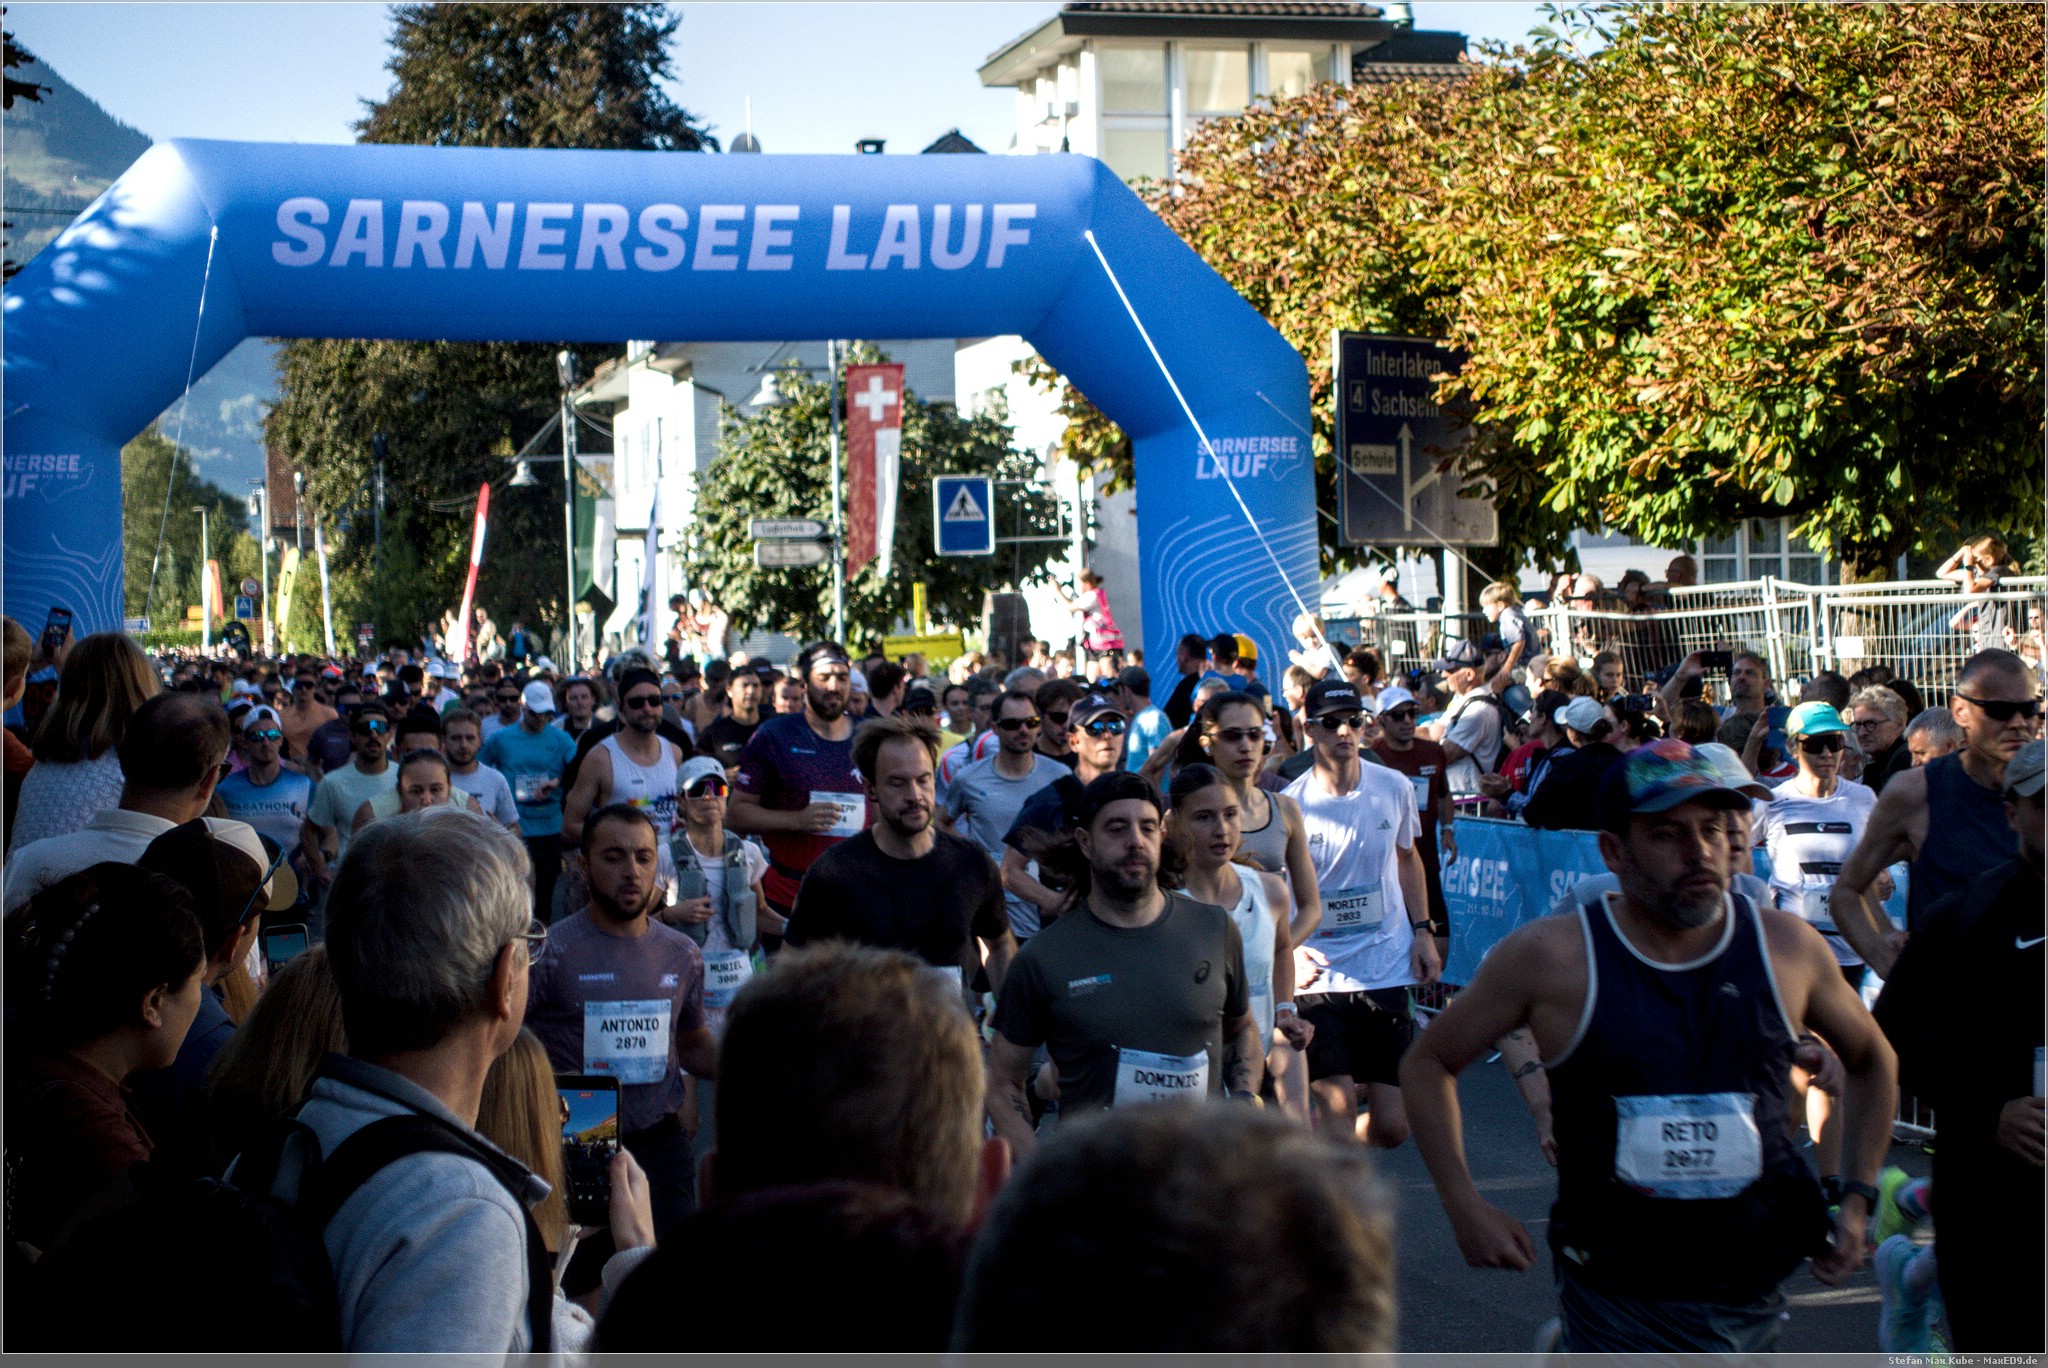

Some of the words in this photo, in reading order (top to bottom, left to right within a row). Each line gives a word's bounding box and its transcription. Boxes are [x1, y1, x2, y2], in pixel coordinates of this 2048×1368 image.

[272, 197, 799, 271] SARNERSEE
[826, 203, 1036, 270] LAUF
[1367, 348, 1441, 379] Interlaken
[1353, 385, 1362, 406] 4
[1197, 436, 1298, 455] SARNERSEE
[1195, 454, 1268, 480] LAUF
[1354, 450, 1394, 468] Schule
[1328, 897, 1368, 911] MORITZ
[710, 961, 742, 972] MURIEL
[600, 1018, 659, 1032] ANTONIO
[616, 1037, 646, 1049] 2870
[1134, 1070, 1200, 1088] DOMINIC
[1662, 1121, 1718, 1142] RETO
